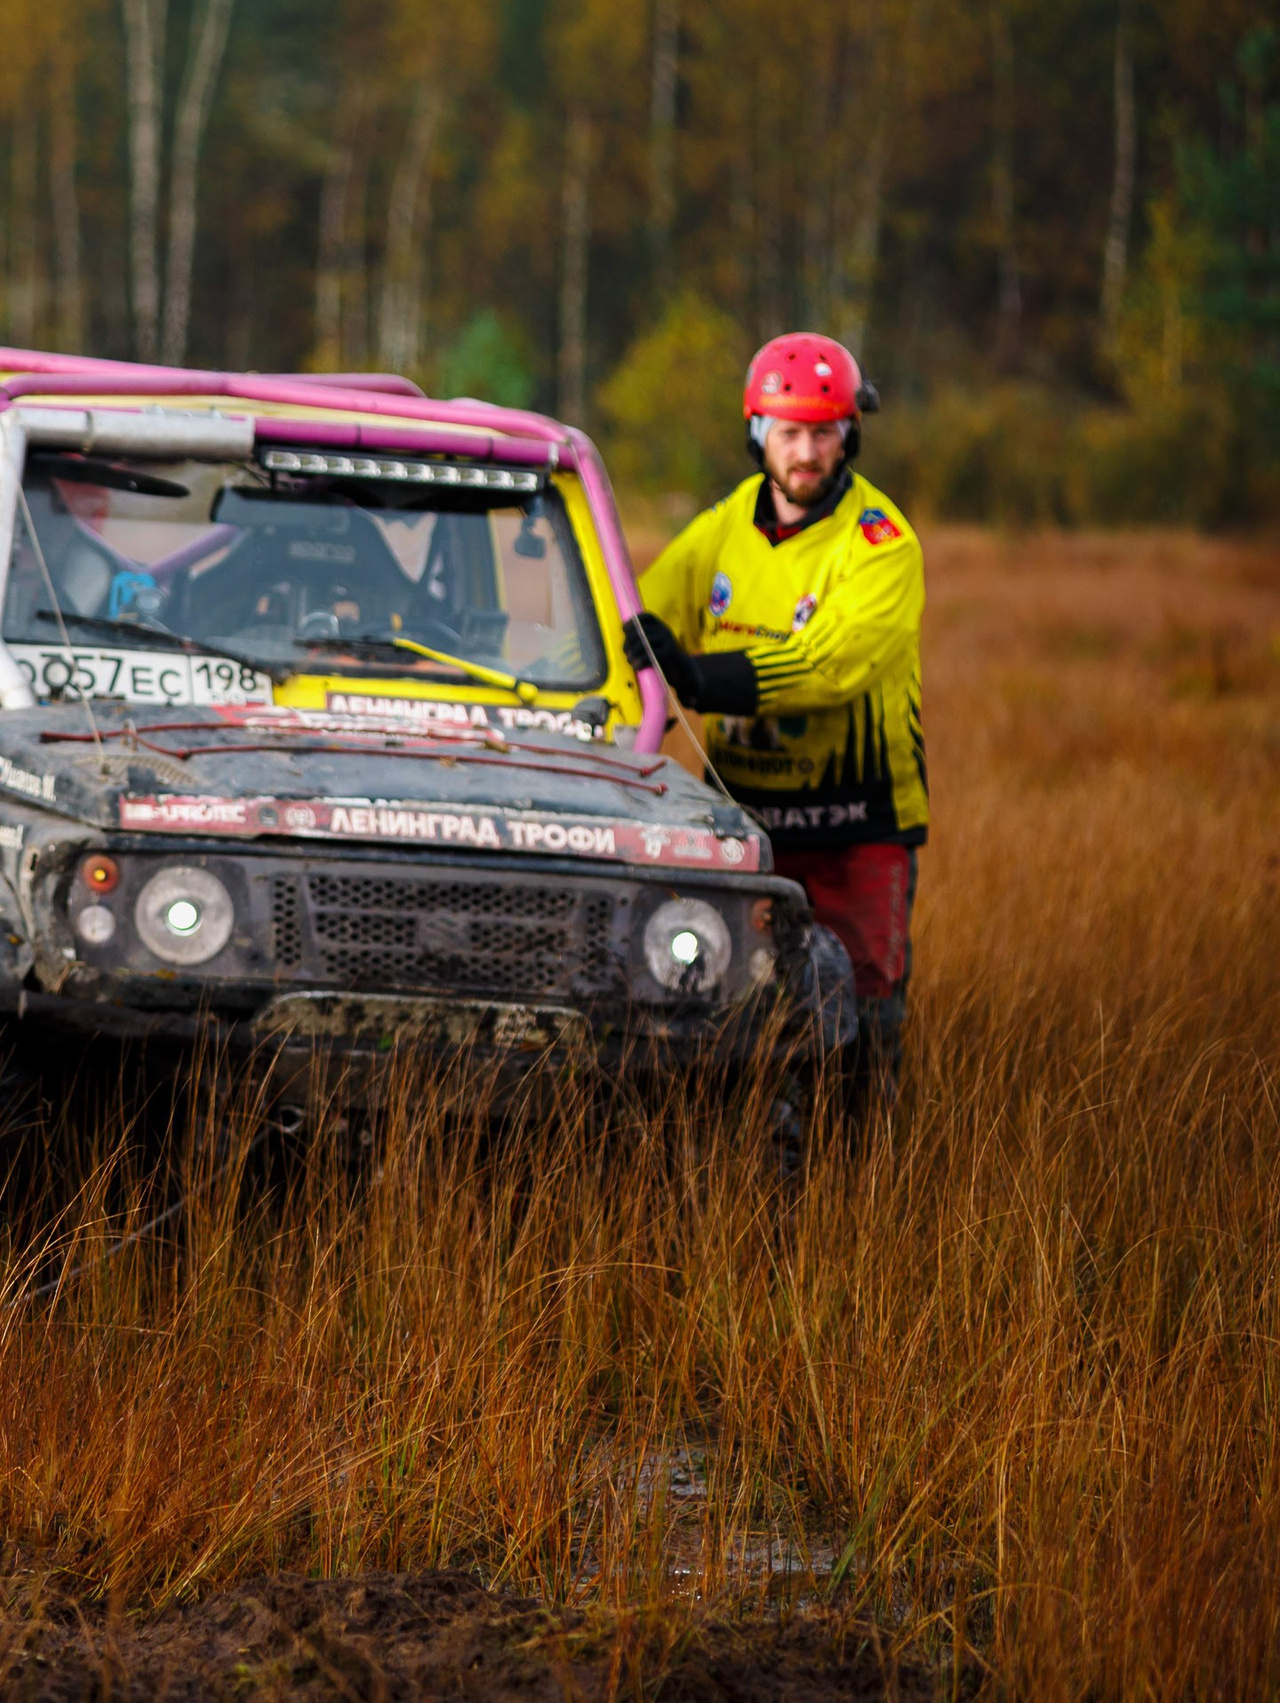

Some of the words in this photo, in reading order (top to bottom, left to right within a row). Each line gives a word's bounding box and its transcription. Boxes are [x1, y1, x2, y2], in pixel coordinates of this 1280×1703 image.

[195, 661, 258, 692] 198
[330, 807, 501, 848] ЛЕНИНГРАД
[506, 819, 616, 853] ТРОФИ
